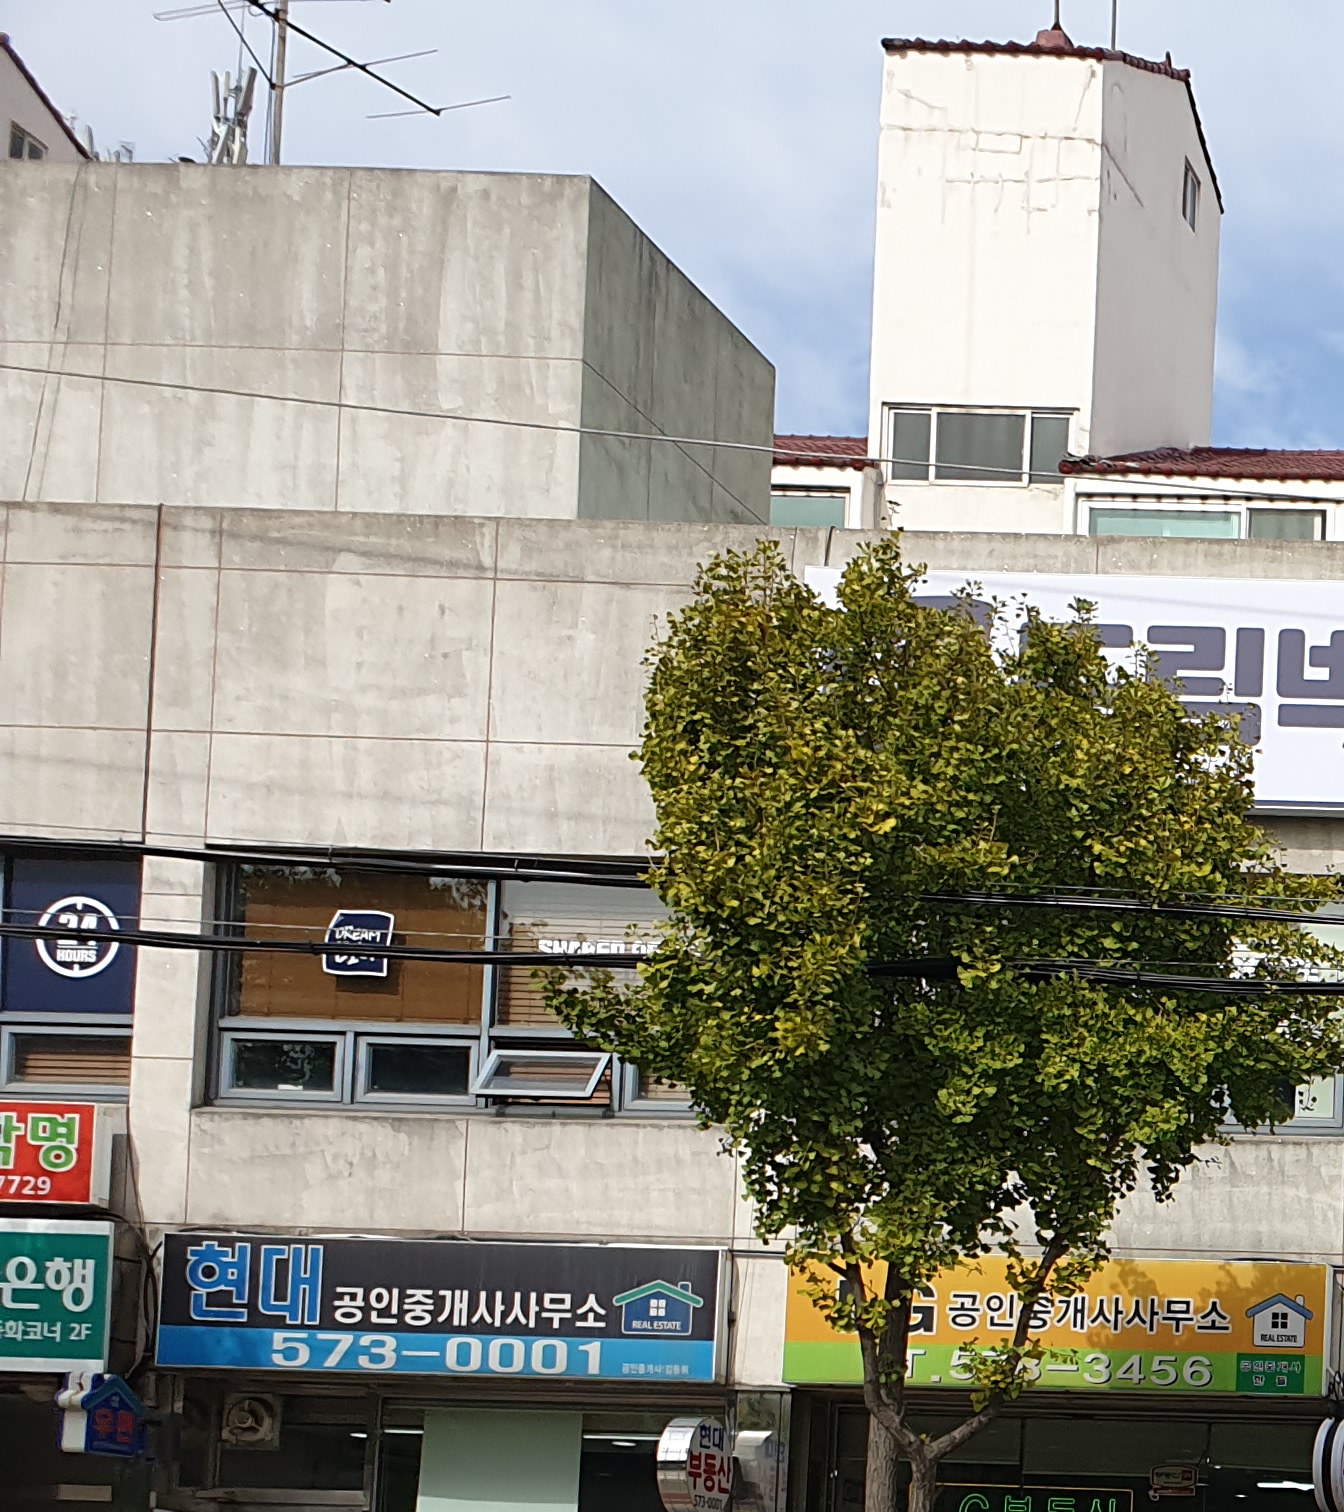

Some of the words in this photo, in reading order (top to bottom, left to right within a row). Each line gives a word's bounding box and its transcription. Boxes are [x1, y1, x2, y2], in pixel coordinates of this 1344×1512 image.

[56, 950, 97, 963] HOURS
[186, 1241, 325, 1326] 현대
[332, 1286, 607, 1329] 공인중개사사무소
[632, 1320, 653, 1330] REAL
[653, 1320, 682, 1331] ESTATE
[946, 1292, 1234, 1335] 공인중개사사무소
[69, 1322, 93, 1341] 2F
[1260, 1333, 1276, 1343] REAL
[1276, 1334, 1298, 1344] ESTATE
[270, 1331, 602, 1376] 573-0001
[700, 1424, 724, 1452] 현대
[688, 1450, 732, 1495] 부동산
